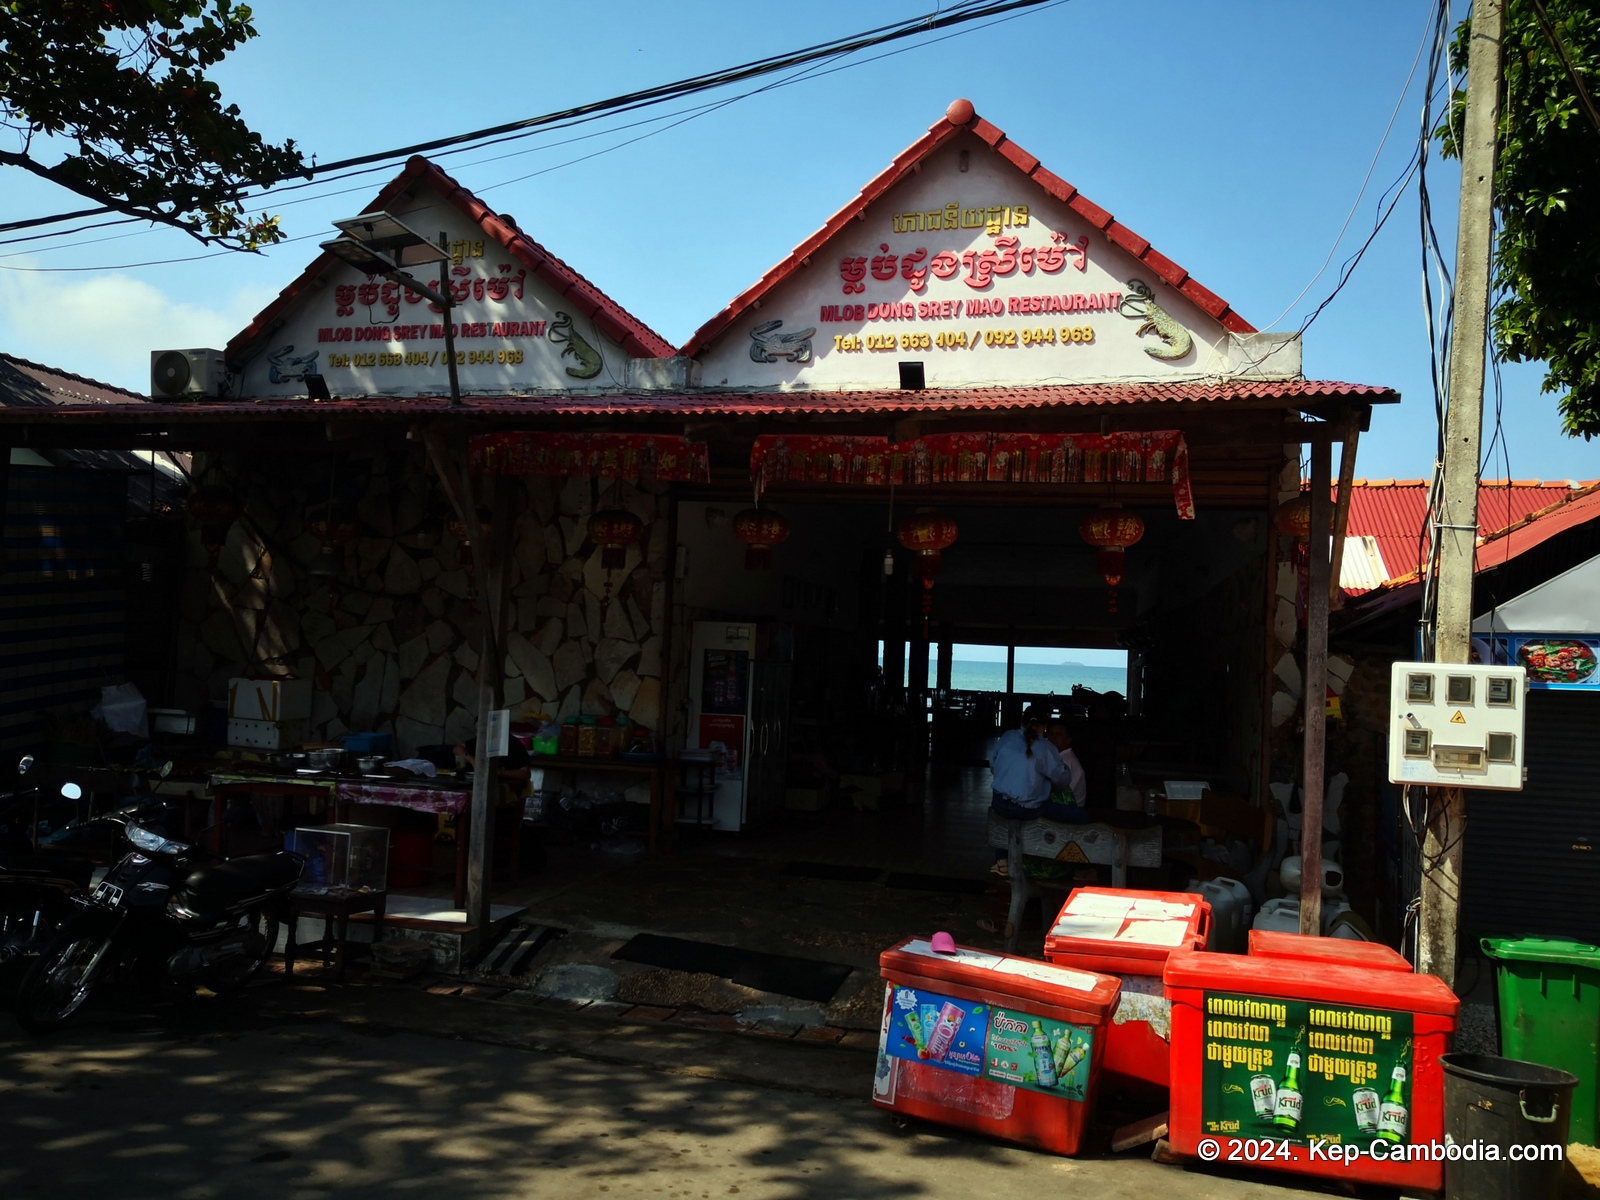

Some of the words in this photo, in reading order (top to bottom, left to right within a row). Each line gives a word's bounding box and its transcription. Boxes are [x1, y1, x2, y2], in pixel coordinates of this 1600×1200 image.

[892, 202, 1029, 235] ភោជនីយដ្ឋាន
[820, 304, 864, 322] MLOB
[867, 302, 914, 320] DONG
[917, 299, 963, 318] SREY
[965, 298, 1003, 316] MAO
[1008, 292, 1121, 314] RESTAURANT
[318, 327, 353, 343] MLOB
[354, 325, 391, 341] DONG
[393, 324, 428, 340] SREY
[461, 320, 547, 338] RESTAURANT
[833, 334, 860, 351] Tel:
[865, 333, 895, 350] 012
[900, 332, 930, 348] 663
[935, 331, 967, 347] 404
[968, 330, 980, 349] /
[984, 329, 1017, 346] 092
[1021, 327, 1054, 343] 944
[1060, 326, 1094, 342] 968
[329, 354, 351, 367] Tel:
[353, 353, 375, 367] 012
[379, 352, 402, 366] 663
[404, 352, 428, 365] 404
[440, 350, 465, 365] 02
[469, 350, 494, 364] 944
[497, 349, 524, 364] 968
[1253, 1084, 1273, 1100] Krud
[1278, 1097, 1301, 1110] Krud
[1355, 1098, 1377, 1114] Krud
[1382, 1110, 1406, 1125] Krud
